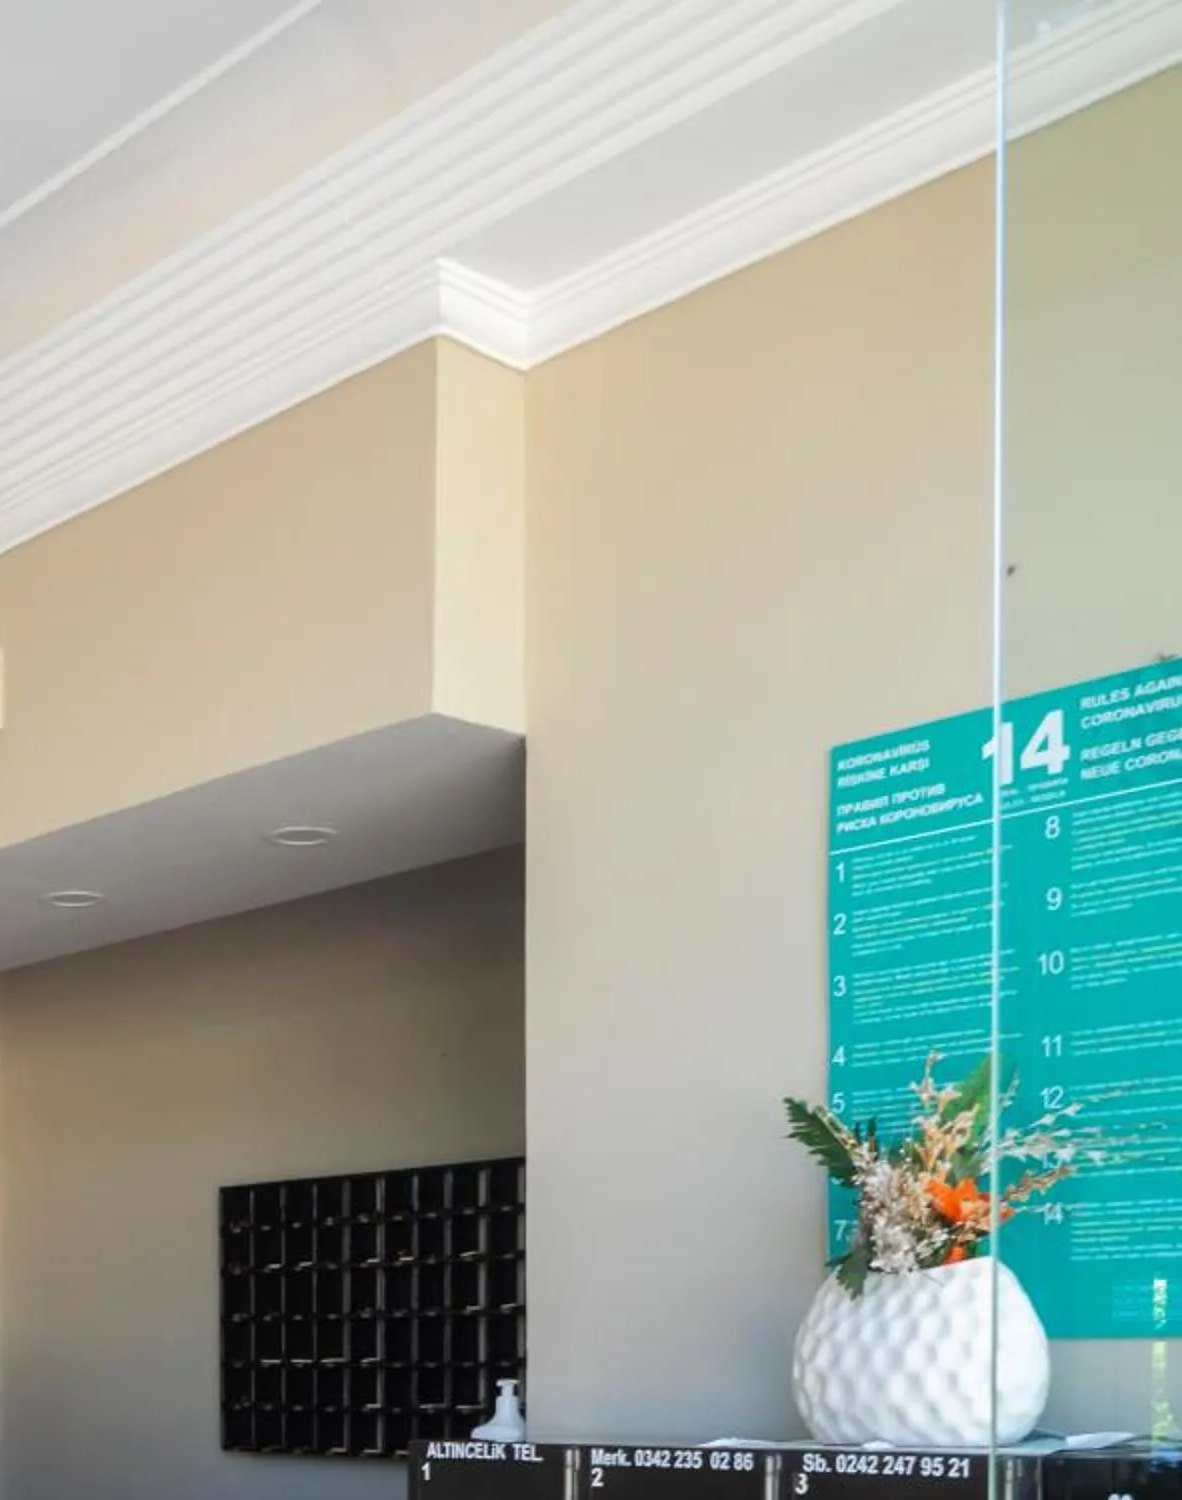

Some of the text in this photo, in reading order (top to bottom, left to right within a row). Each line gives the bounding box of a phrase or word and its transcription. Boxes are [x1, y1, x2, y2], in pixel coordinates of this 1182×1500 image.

[1080, 687, 1130, 709] RULES
[981, 709, 1070, 786] 14
[1080, 737, 1142, 760] REGELN
[1045, 816, 1060, 839] 8
[836, 862, 845, 882] 1
[1046, 887, 1062, 911] 9
[833, 914, 846, 935] 2
[1038, 951, 1064, 976] 10
[833, 976, 846, 997] 3
[833, 1045, 845, 1066] 4
[1041, 1034, 1062, 1057] 11
[833, 1092, 844, 1113] 5
[1041, 1085, 1064, 1109] 12
[1042, 1202, 1063, 1225] 14
[833, 1220, 846, 1241] 7
[512, 1443, 545, 1461] TEL.
[591, 1448, 753, 1470] Merk. 0342 235 02 86
[421, 1462, 431, 1481] 1
[802, 1453, 969, 1478] Sb. 0242 247 95 21
[590, 1468, 604, 1488] 2
[794, 1472, 809, 1495] 3
